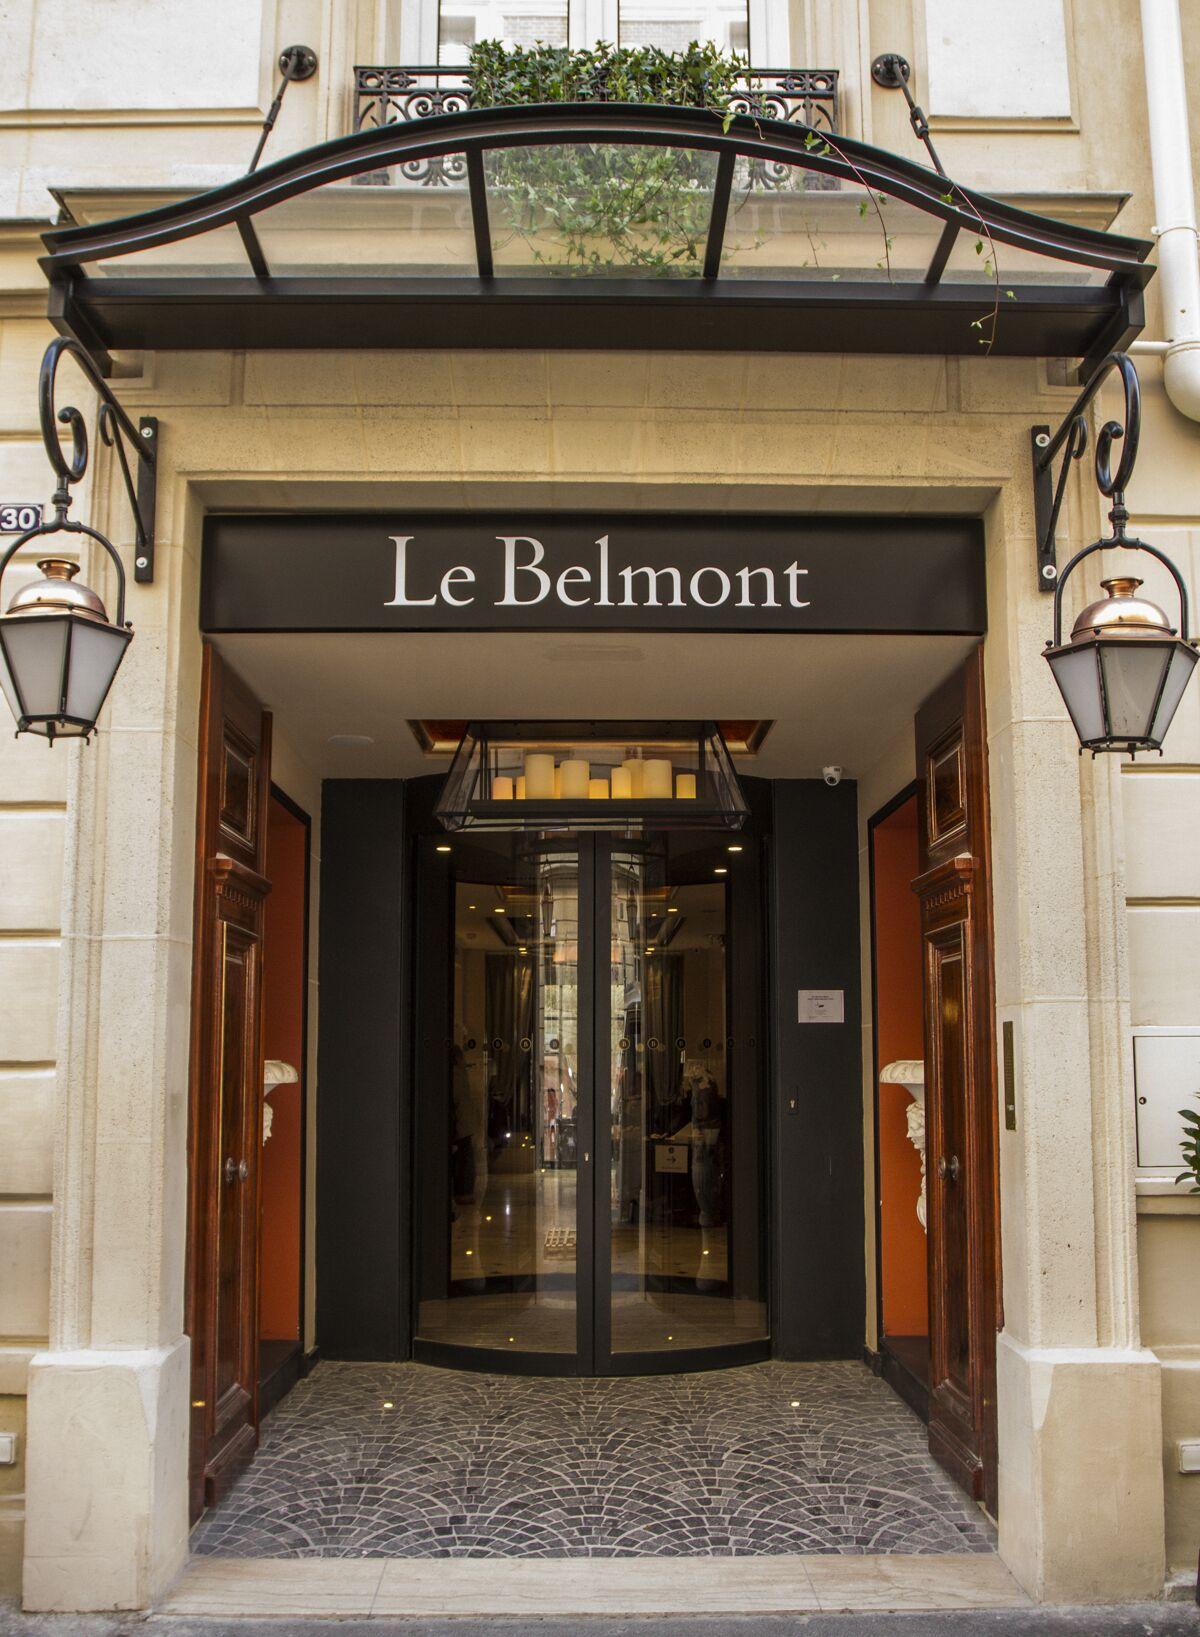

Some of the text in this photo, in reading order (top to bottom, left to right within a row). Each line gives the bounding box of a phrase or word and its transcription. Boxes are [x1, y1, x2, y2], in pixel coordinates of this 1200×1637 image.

[1, 508, 36, 530] 30
[384, 534, 811, 608] Le Belmont
